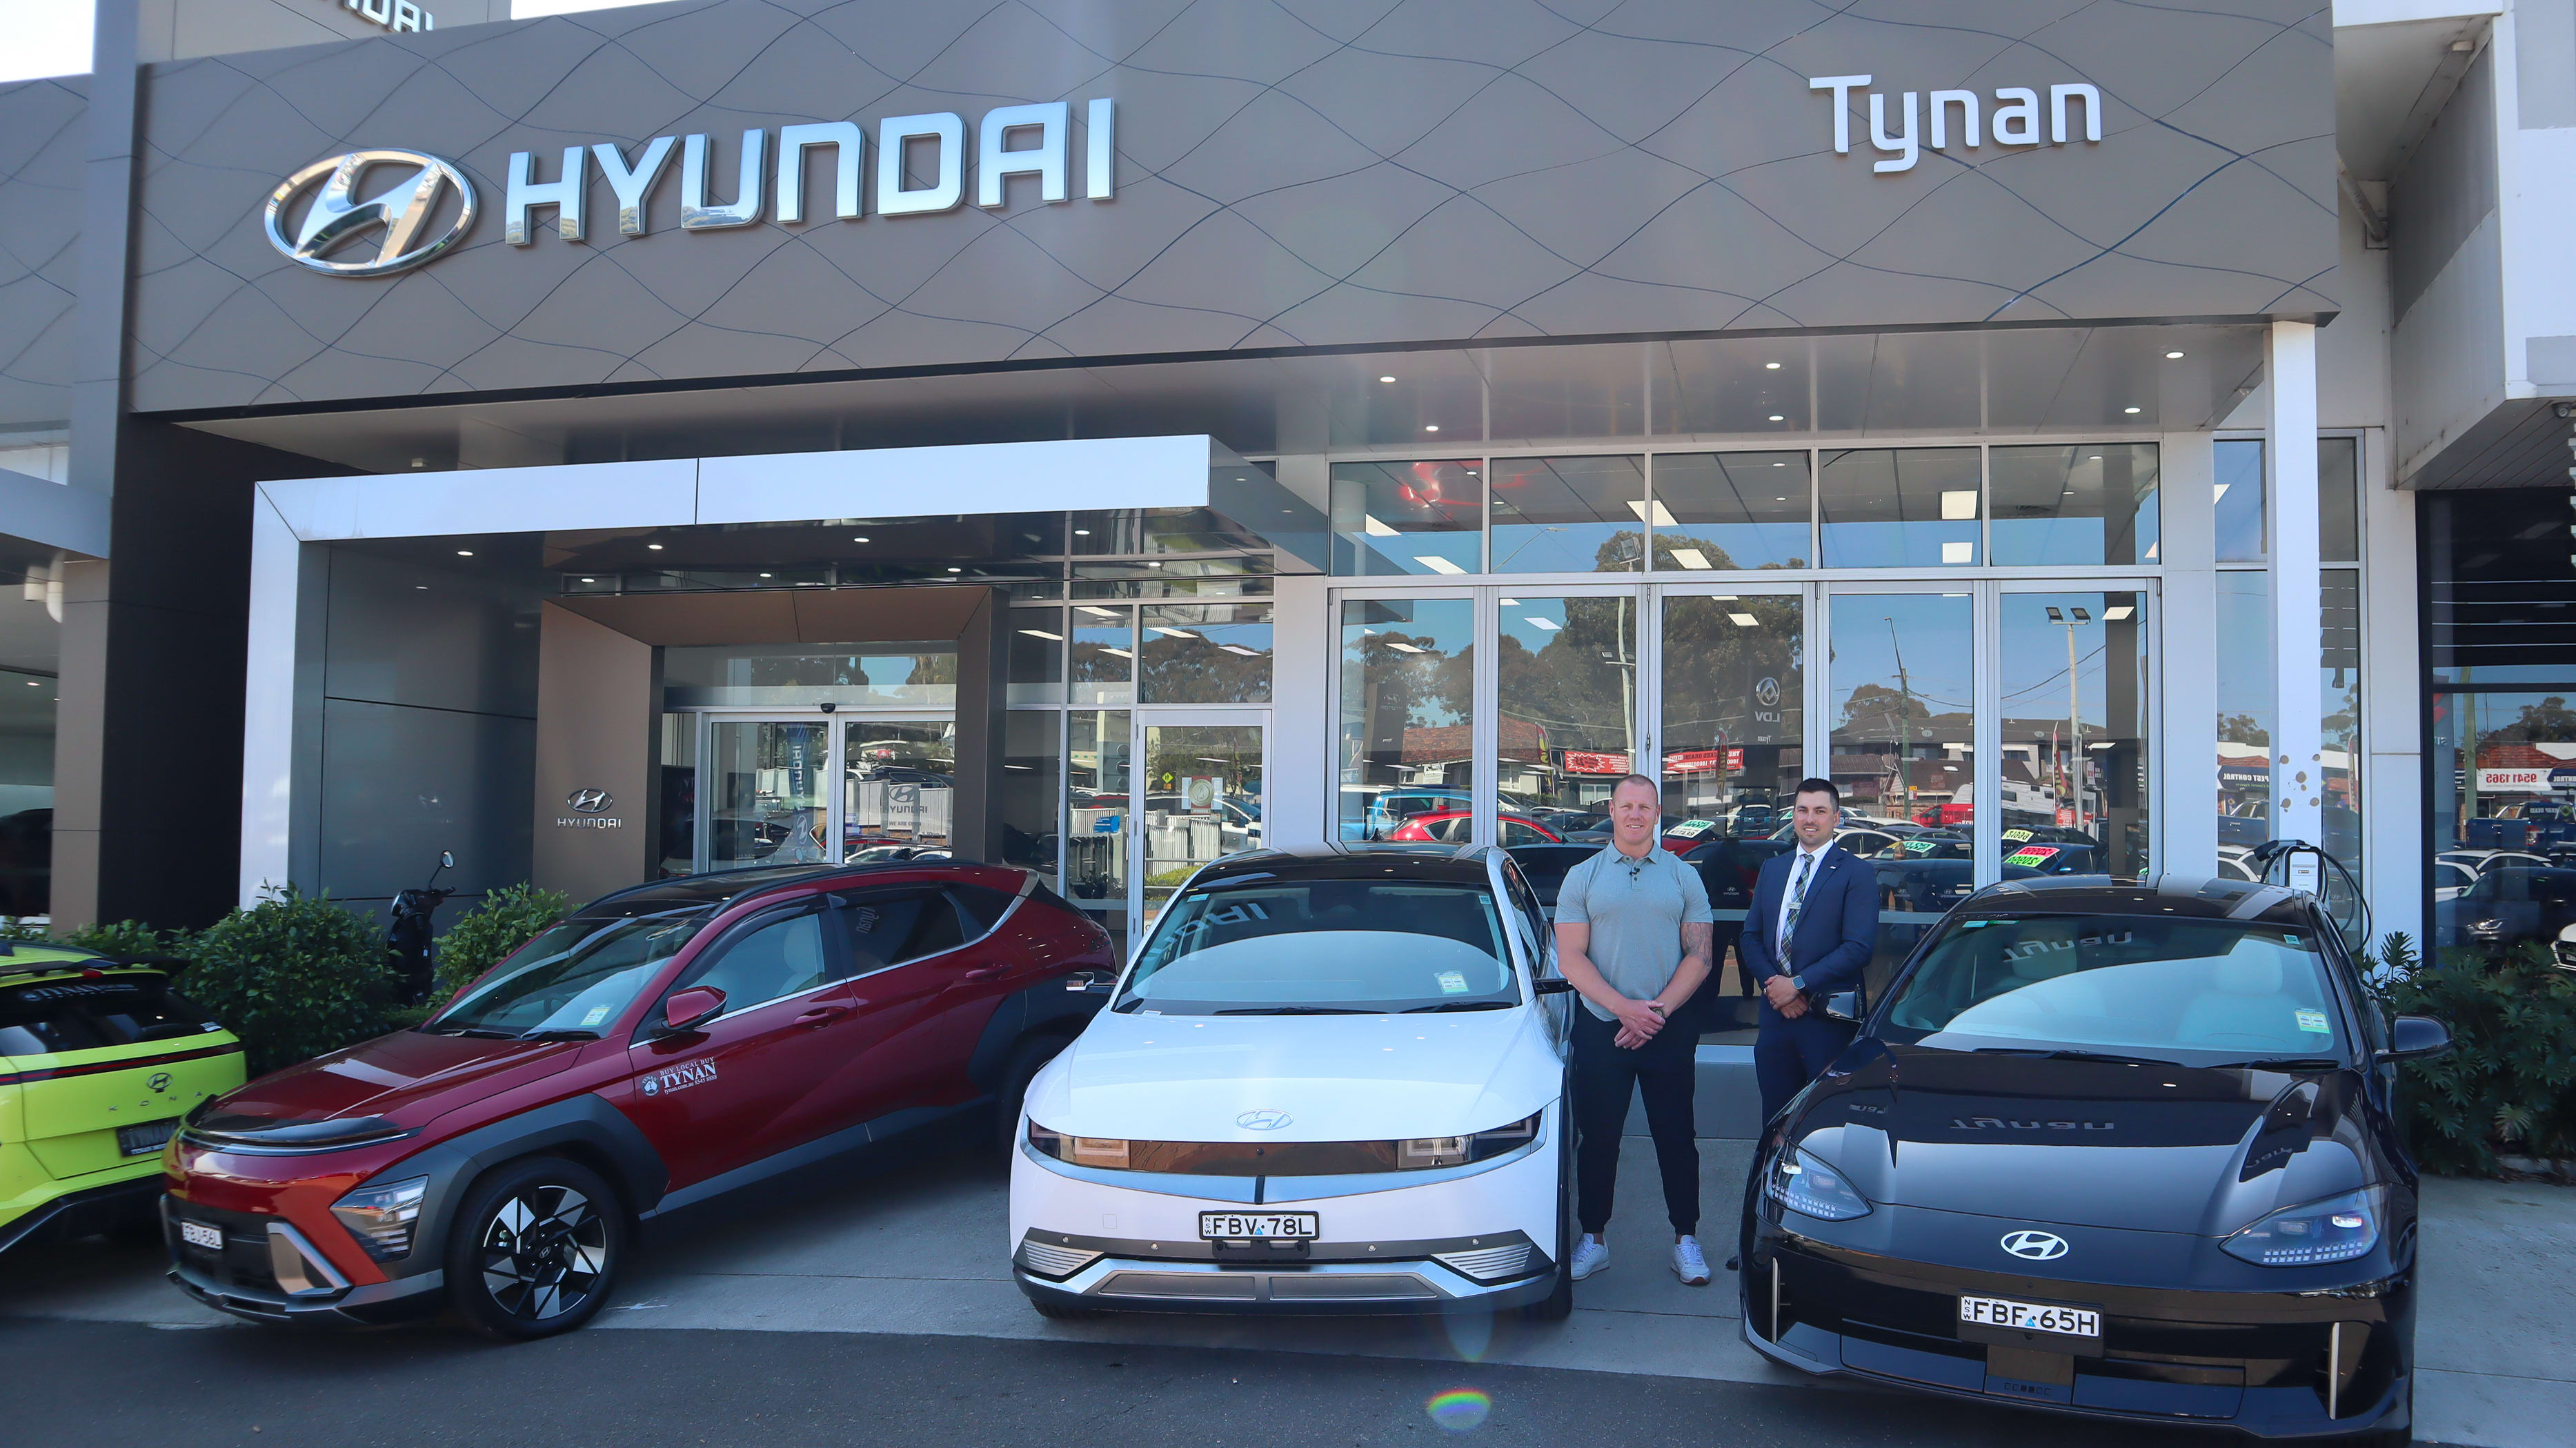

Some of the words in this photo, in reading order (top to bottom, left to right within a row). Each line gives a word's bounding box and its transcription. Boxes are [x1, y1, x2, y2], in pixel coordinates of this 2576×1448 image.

[1809, 74, 2101, 173] Tynan
[505, 97, 1114, 246] HYUNDAI
[557, 817, 622, 829] HYUNDAI
[660, 1068, 673, 1076] BUY
[676, 1060, 699, 1071] LOCAL
[700, 1056, 715, 1065] BUY
[660, 1062, 716, 1089] TYNAN
[108, 1091, 203, 1112] KONA
